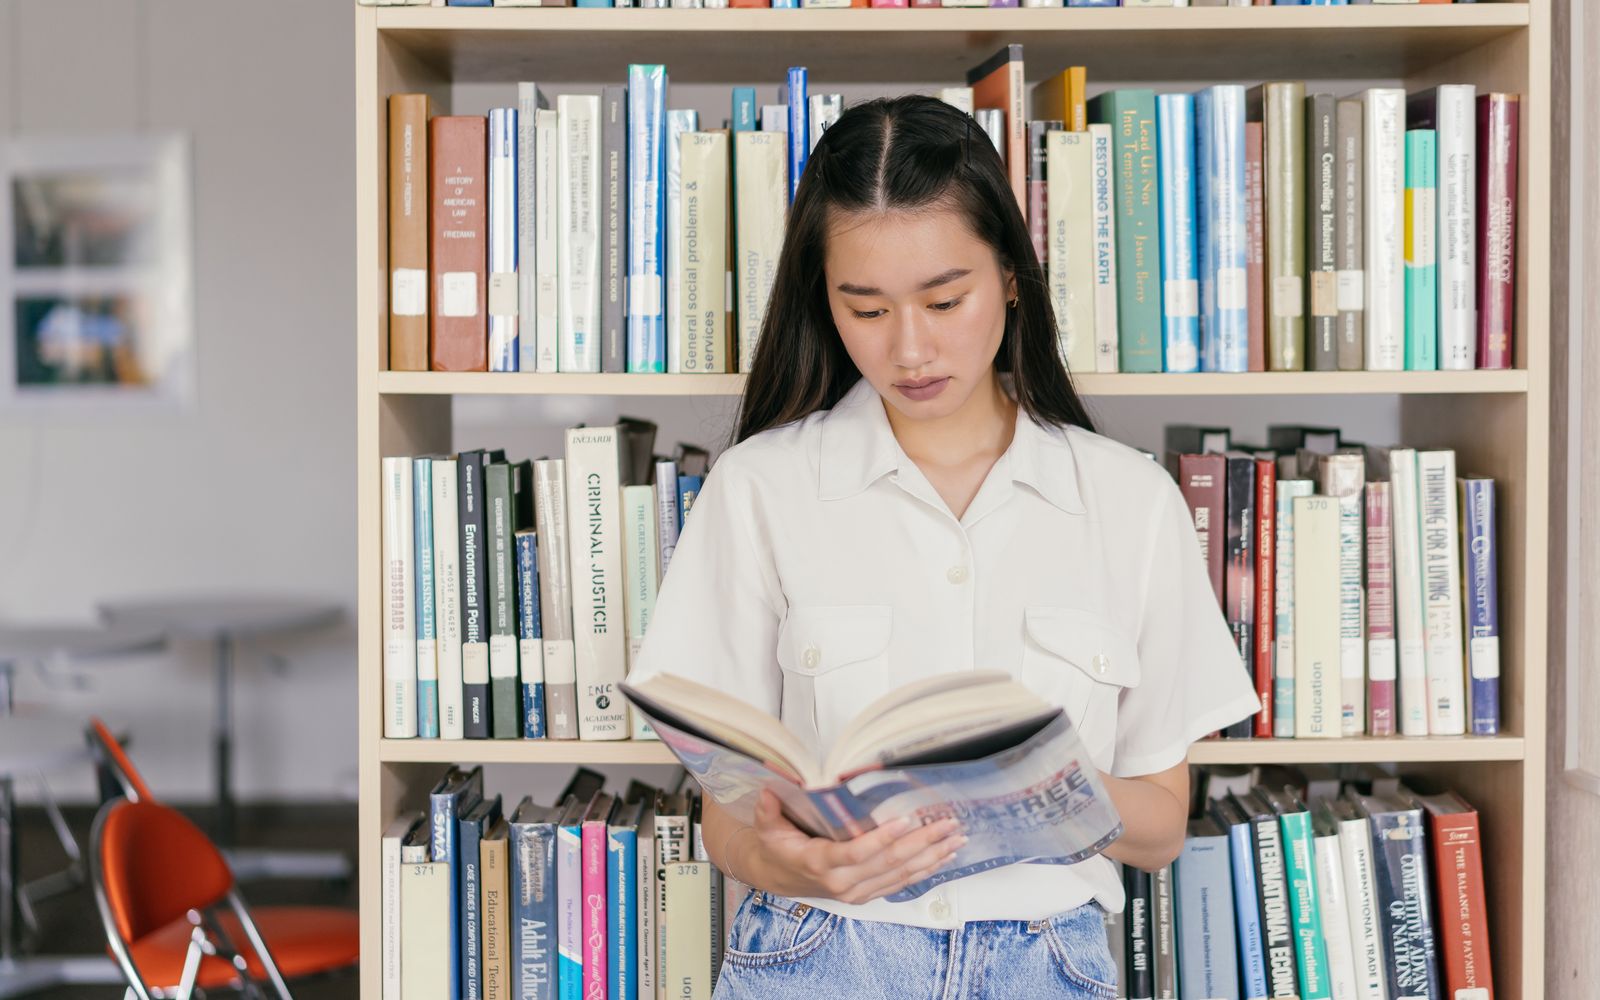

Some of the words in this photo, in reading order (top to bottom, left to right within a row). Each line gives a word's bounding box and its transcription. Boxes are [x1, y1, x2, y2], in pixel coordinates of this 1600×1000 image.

[1122, 109, 1137, 137] Into
[1139, 119, 1153, 150] Lead
[750, 135, 770, 145] 362
[1061, 135, 1080, 145] 363
[456, 166, 463, 174] A
[609, 151, 619, 179] PUBLIC
[1095, 136, 1109, 212] RESTORING
[1122, 140, 1139, 217] Temptation
[1140, 155, 1153, 175] Us
[445, 176, 474, 185] HISTORY
[454, 187, 465, 196] OF
[685, 180, 697, 191] &
[1141, 179, 1154, 206] Not
[1319, 152, 1335, 212] Controlling
[443, 198, 476, 206] AMERICAN
[609, 181, 619, 210] POLICY
[452, 209, 466, 217] LAW
[609, 213, 619, 229] AND
[1097, 214, 1109, 238] THE
[443, 230, 476, 239] FRIEDMAN
[609, 230, 619, 246] THE
[685, 196, 700, 263] problems
[1321, 213, 1335, 263] Industrial
[1447, 218, 1458, 261] Handbook
[1500, 196, 1513, 284] CRIMINOLOGY
[609, 248, 619, 277] PUBLIC
[1055, 219, 1067, 278] services
[1097, 241, 1111, 285] EARTH
[609, 279, 619, 302] GOOD
[685, 267, 698, 310] social
[746, 250, 760, 321] pathology
[1055, 284, 1068, 325] social
[685, 314, 698, 370] General
[703, 311, 714, 370] services
[572, 434, 612, 444] INCIARDI
[467, 495, 475, 513] Smith
[682, 490, 691, 509] THE
[1306, 500, 1327, 510] 370
[1425, 465, 1448, 524] THINKING
[494, 497, 504, 537] GOVERNMENT
[585, 473, 605, 558] CRIMINAL
[637, 504, 646, 522] THE
[1195, 506, 1209, 530] RISK
[495, 538, 504, 551] AND
[638, 523, 647, 554] GREEN
[1426, 528, 1449, 550] FOR
[422, 547, 432, 572] THE
[464, 523, 480, 607] Environmental
[1427, 553, 1449, 562] A
[1471, 535, 1491, 609] COMMUNITY
[446, 563, 455, 594] WHOSE
[495, 552, 506, 599] ENVIRONMENTAL
[523, 570, 532, 586] THE
[638, 555, 649, 601] ECONOMY
[1428, 564, 1451, 602] LIVING
[390, 559, 406, 631] CROSSROADS
[423, 574, 432, 612] RISING
[524, 586, 533, 601] HOLE
[590, 563, 608, 634] JUSTICE
[424, 614, 433, 640] TID
[447, 597, 457, 639] HUNGER?
[466, 609, 481, 644] Politic
[497, 601, 507, 628] POLITICS
[471, 697, 480, 724] PRAEGER
[1310, 661, 1323, 734] Education
[583, 714, 625, 725] ACADEMIC
[592, 722, 617, 732] PRESS
[434, 812, 447, 861] SMA
[1292, 839, 1307, 870] Milner
[1455, 847, 1465, 869] THE
[414, 866, 434, 876] 371
[466, 864, 475, 881] CASE
[678, 864, 699, 876] 378
[1257, 820, 1289, 946] INTERNATIONAL
[466, 882, 475, 910] STUDIES
[618, 871, 626, 904] ACADEMIC
[1159, 883, 1168, 896] and
[1294, 879, 1312, 924] Resisting
[1399, 853, 1423, 941] COMPETITIVE
[1457, 872, 1469, 920] BALANCE
[467, 911, 475, 920] IN
[566, 898, 574, 910] The
[1131, 897, 1146, 938] Globalizing
[1159, 897, 1169, 923] Market
[1200, 887, 1210, 933] International
[1357, 849, 1375, 940] INTERNATIONAL
[1366, 943, 1378, 979] TRADE
[1389, 900, 1407, 920] OF
[487, 889, 499, 961] Educational
[566, 911, 574, 935] Politics
[618, 905, 626, 937] SUBJECTS
[1462, 922, 1472, 936] OF
[467, 920, 476, 956] COMPUTER
[521, 917, 547, 960] Adult
[1133, 939, 1146, 952] the
[1161, 923, 1170, 956] Structure
[1203, 934, 1212, 968] Business
[1247, 921, 1258, 952] Saving
[468, 957, 477, 977] AIDED
[618, 945, 626, 972] DIVERSE
[1133, 953, 1147, 971] GATT
[1252, 954, 1261, 974] Free
[1299, 928, 1318, 993] Protectionism
[1391, 923, 1412, 988] NATIONS
[1463, 940, 1476, 990] PAYMENT
[487, 964, 499, 1000] Techn
[521, 962, 548, 1000] Educ
[618, 973, 626, 1000] LEARNE
[1269, 946, 1295, 998] ECONO
[469, 978, 478, 1000] LEARN
[1254, 977, 1264, 997] Trad
